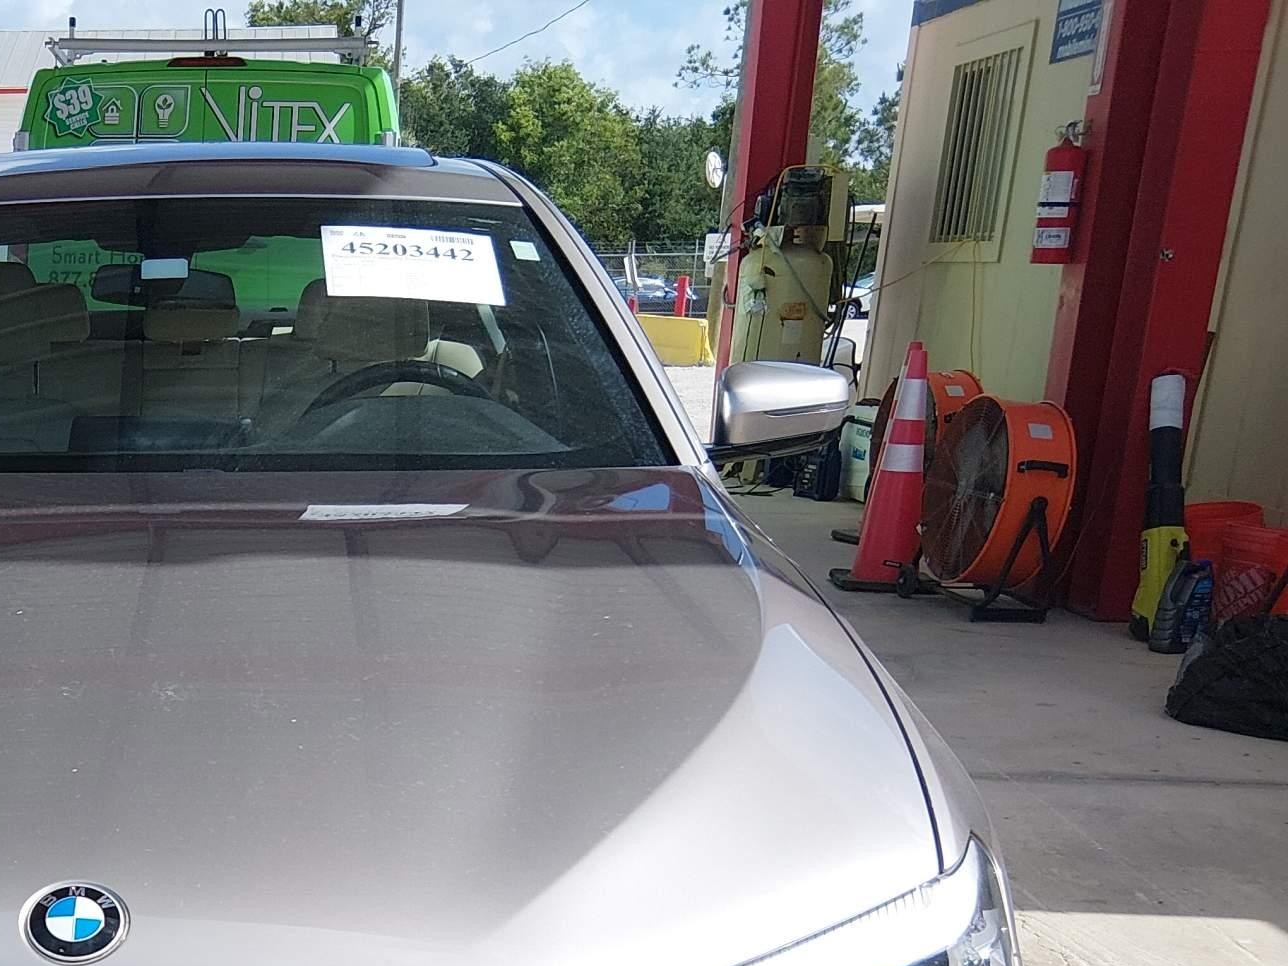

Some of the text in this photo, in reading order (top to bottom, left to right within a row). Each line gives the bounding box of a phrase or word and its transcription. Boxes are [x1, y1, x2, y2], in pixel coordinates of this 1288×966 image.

[53, 84, 94, 120] $39
[52, 246, 100, 264] Smart
[341, 241, 475, 262] 45203442
[40, 886, 115, 909] BMW
